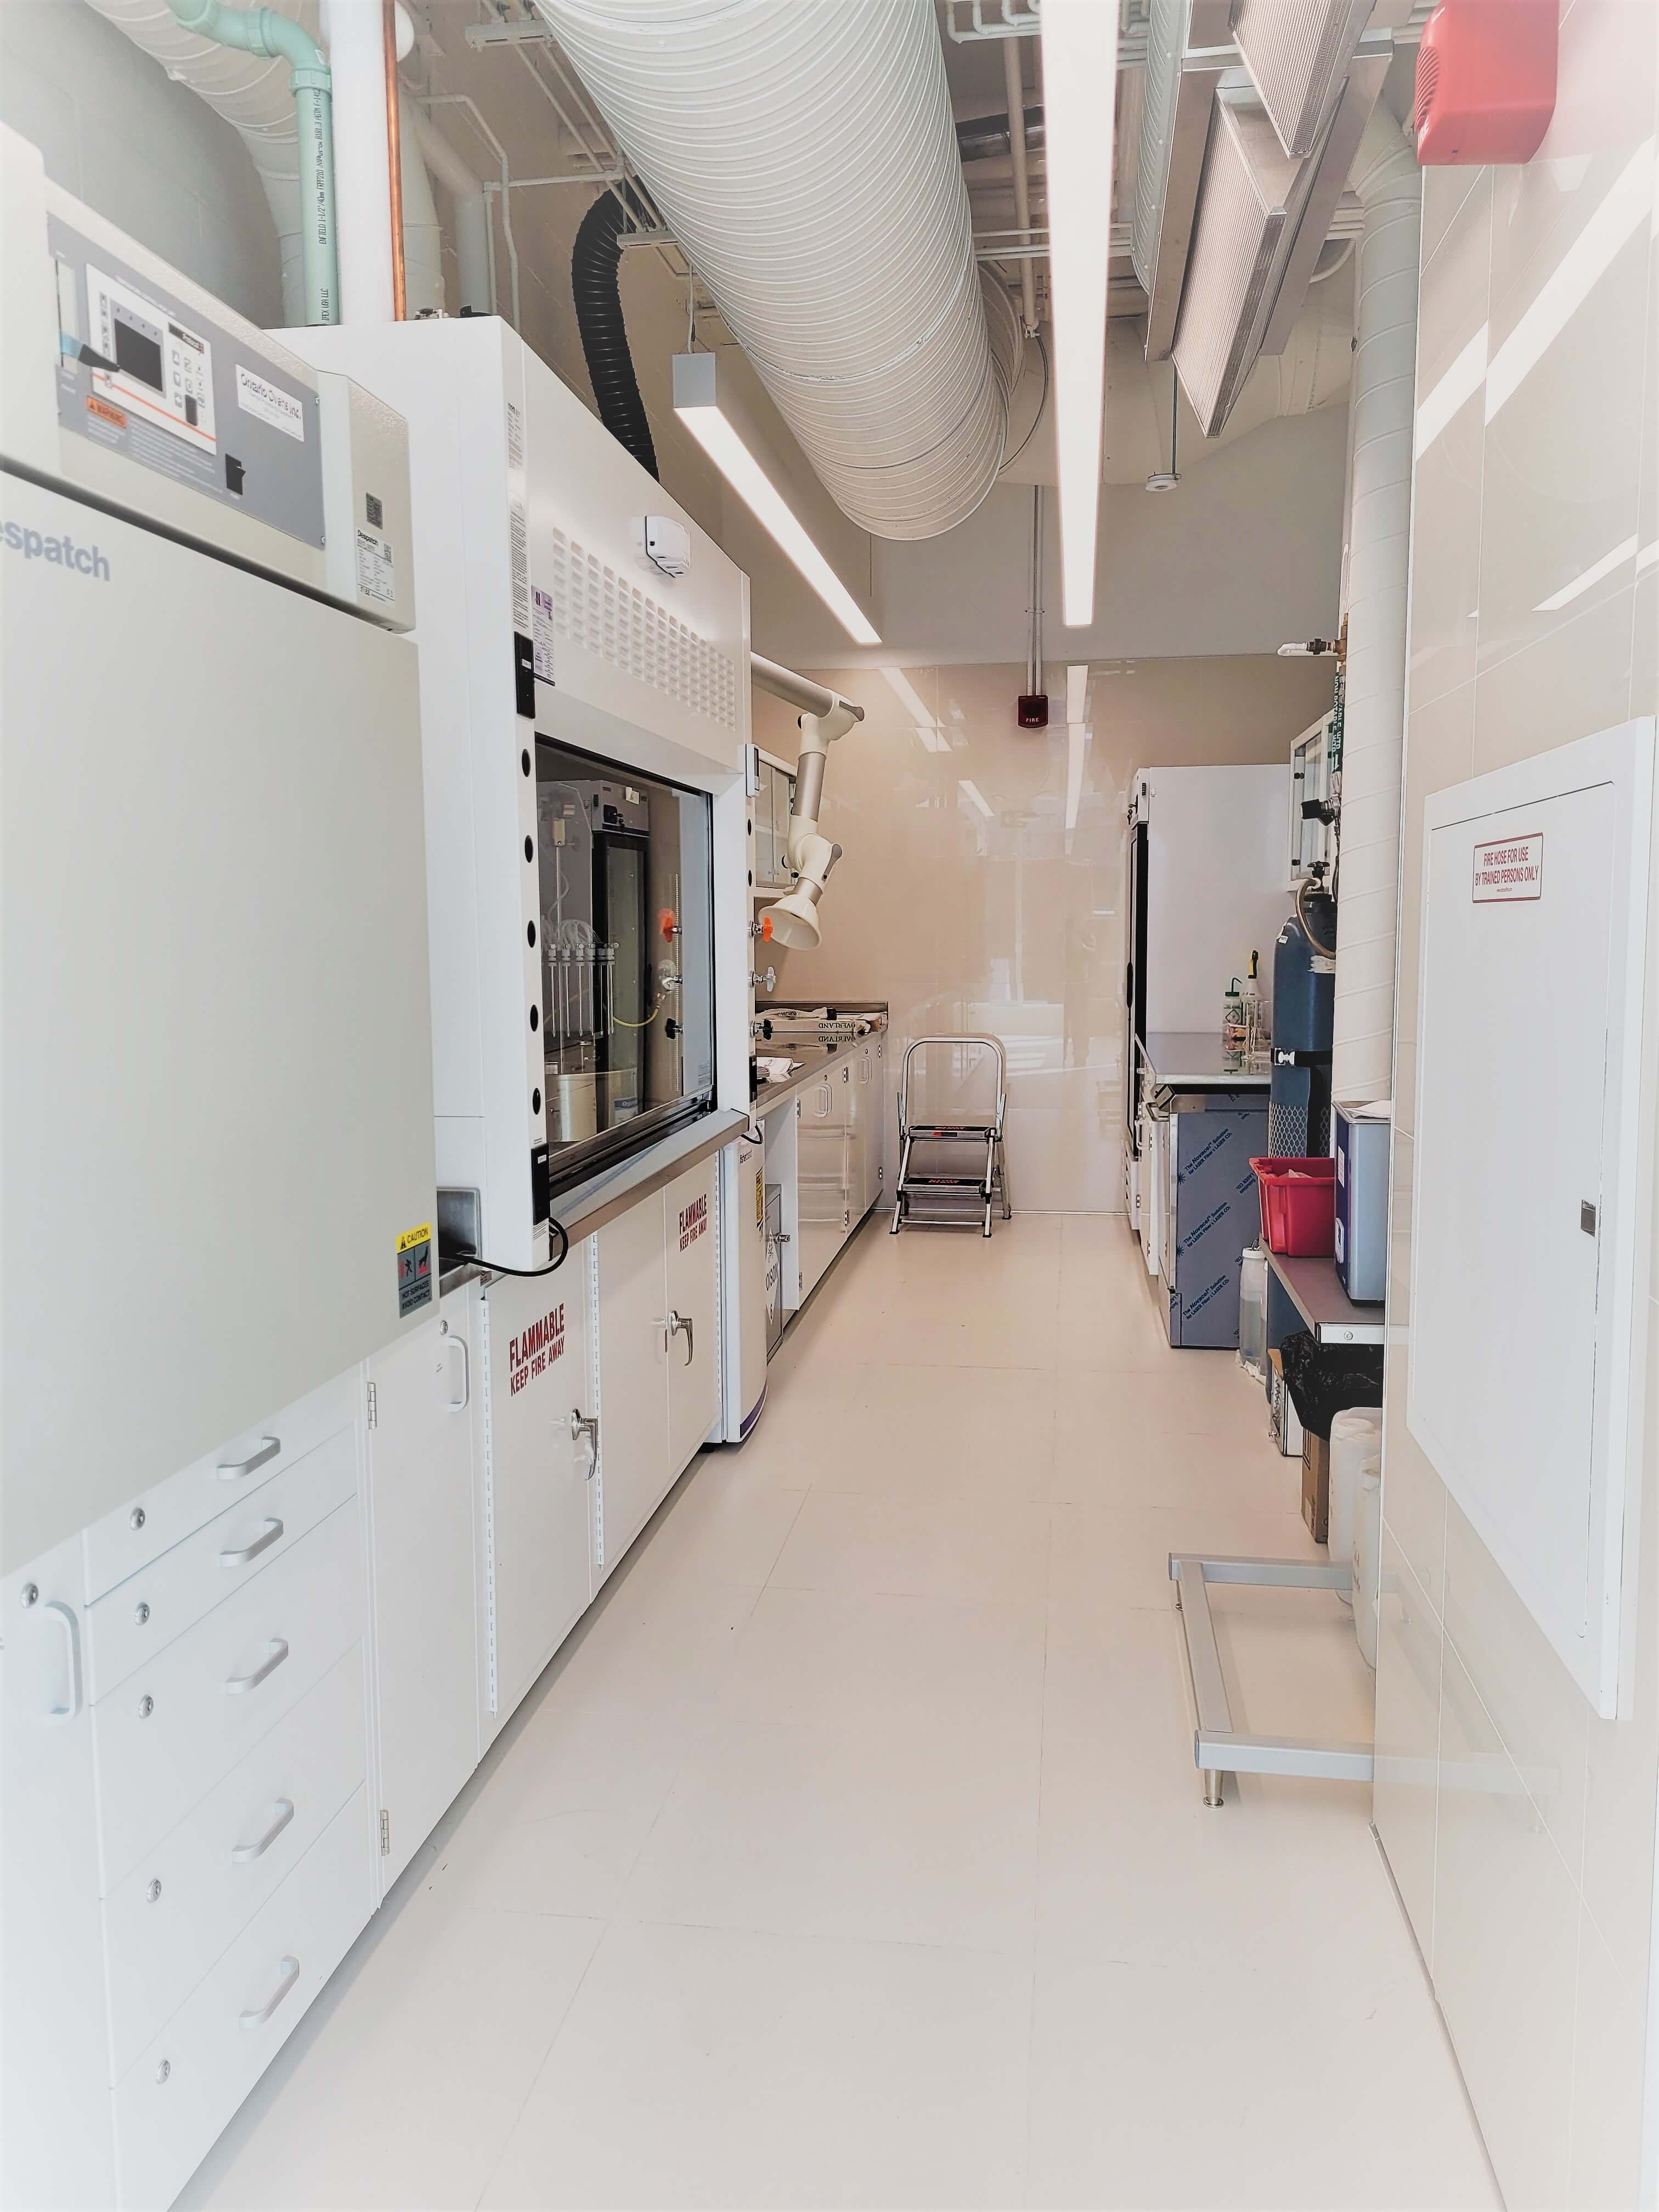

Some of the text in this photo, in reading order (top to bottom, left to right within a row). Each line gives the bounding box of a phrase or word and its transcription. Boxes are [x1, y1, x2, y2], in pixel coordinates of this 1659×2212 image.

[316, 170, 324, 189] FRPP210
[318, 224, 326, 244] ENFIELD
[320, 288, 329, 297] LLC
[0, 519, 110, 582] spatch
[1484, 846, 1528, 867] FIRE HOSE FOR USE
[1475, 865, 1539, 886] BY TRAINED PERSONS ONLY
[1194, 1159, 1205, 1170] LASER
[679, 1193, 707, 1235] FLAMMABLE
[407, 1227, 428, 1243] CAUTION
[680, 1217, 707, 1252] KEEP FIRE AWAY
[410, 1280, 429, 1295] SURFACES
[402, 1289, 430, 1309] AVOID CONTACT
[510, 1302, 565, 1373] FLAMMABLE
[511, 1336, 565, 1397] KEEP FIRE AWAY
